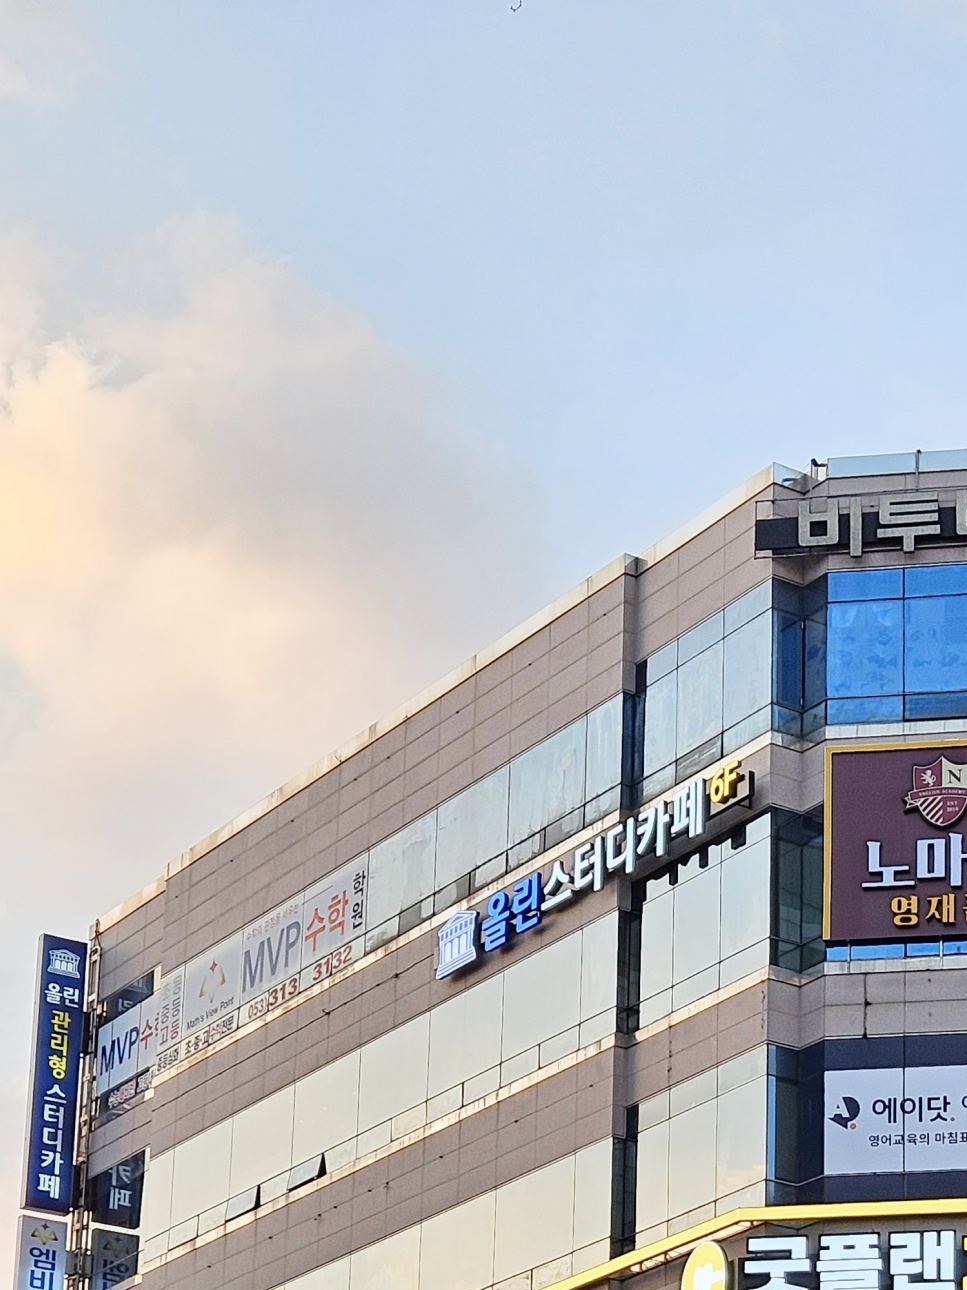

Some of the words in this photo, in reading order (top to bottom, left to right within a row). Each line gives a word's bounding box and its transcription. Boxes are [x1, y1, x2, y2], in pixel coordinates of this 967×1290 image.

[709, 759, 742, 803] 6F
[947, 769, 963, 784] N
[242, 920, 301, 993] MVP
[305, 890, 349, 952] 수학
[45, 982, 80, 1009] 올린
[269, 977, 298, 1007] 313
[48, 1009, 71, 1080] 관리형
[100, 1026, 139, 1076] MVP
[37, 1084, 67, 1199] 스터디카페
[868, 1133, 931, 1147] 영어교육의
